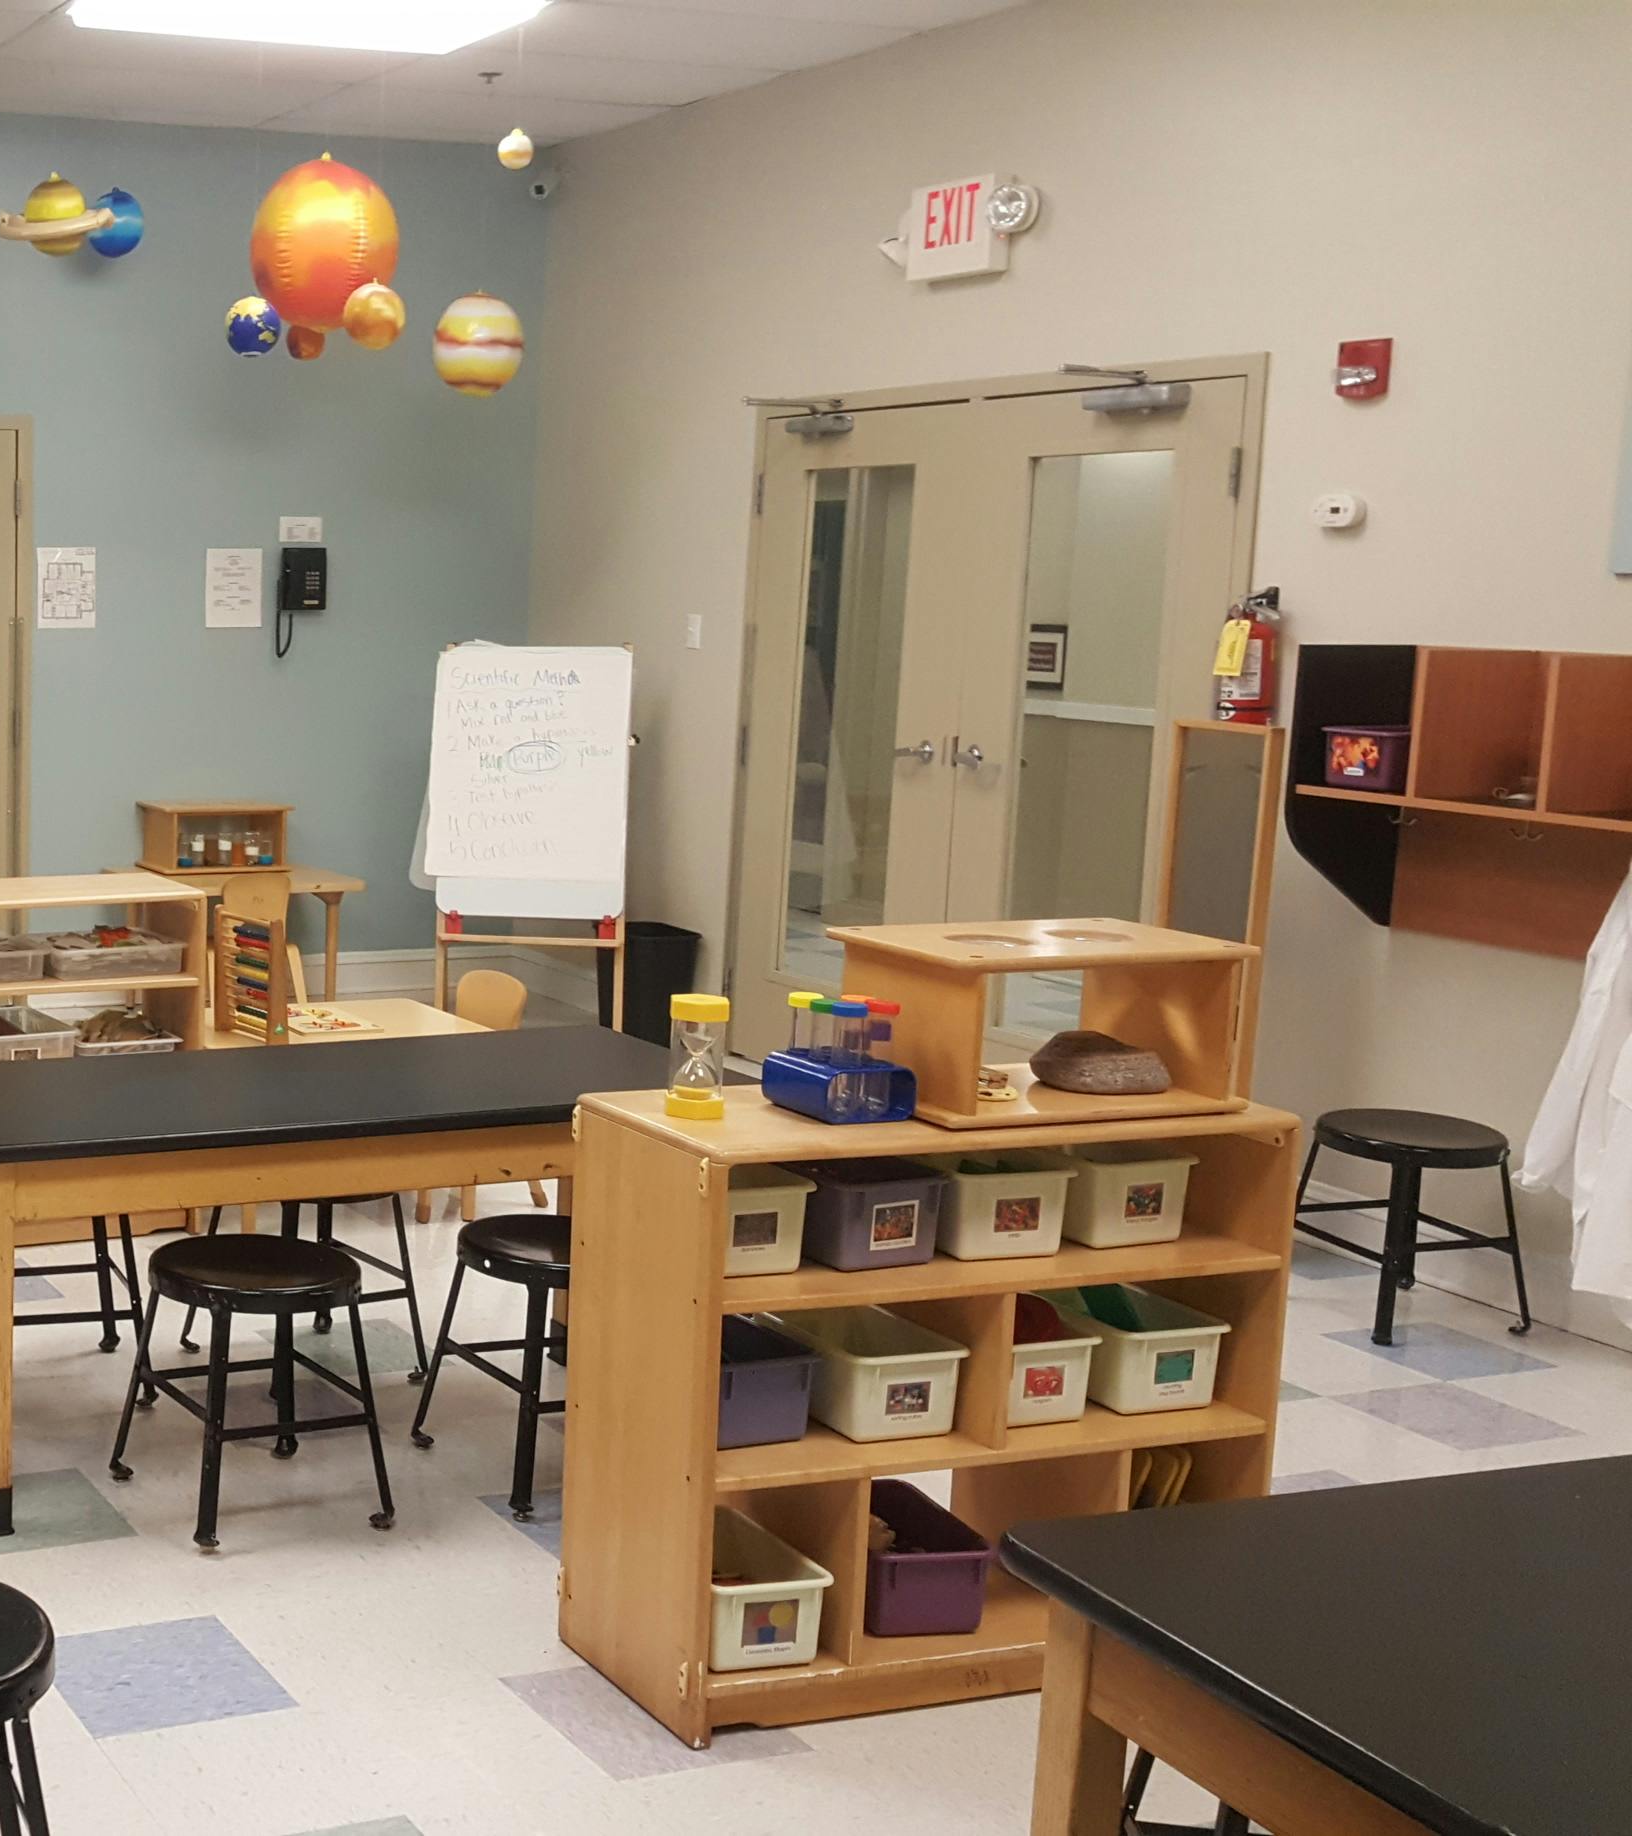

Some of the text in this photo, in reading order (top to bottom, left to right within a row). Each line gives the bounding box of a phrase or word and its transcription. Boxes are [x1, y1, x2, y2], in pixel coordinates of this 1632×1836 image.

[924, 182, 981, 249] EXIT
[451, 666, 520, 689] Scientific
[456, 698, 479, 713] Ask
